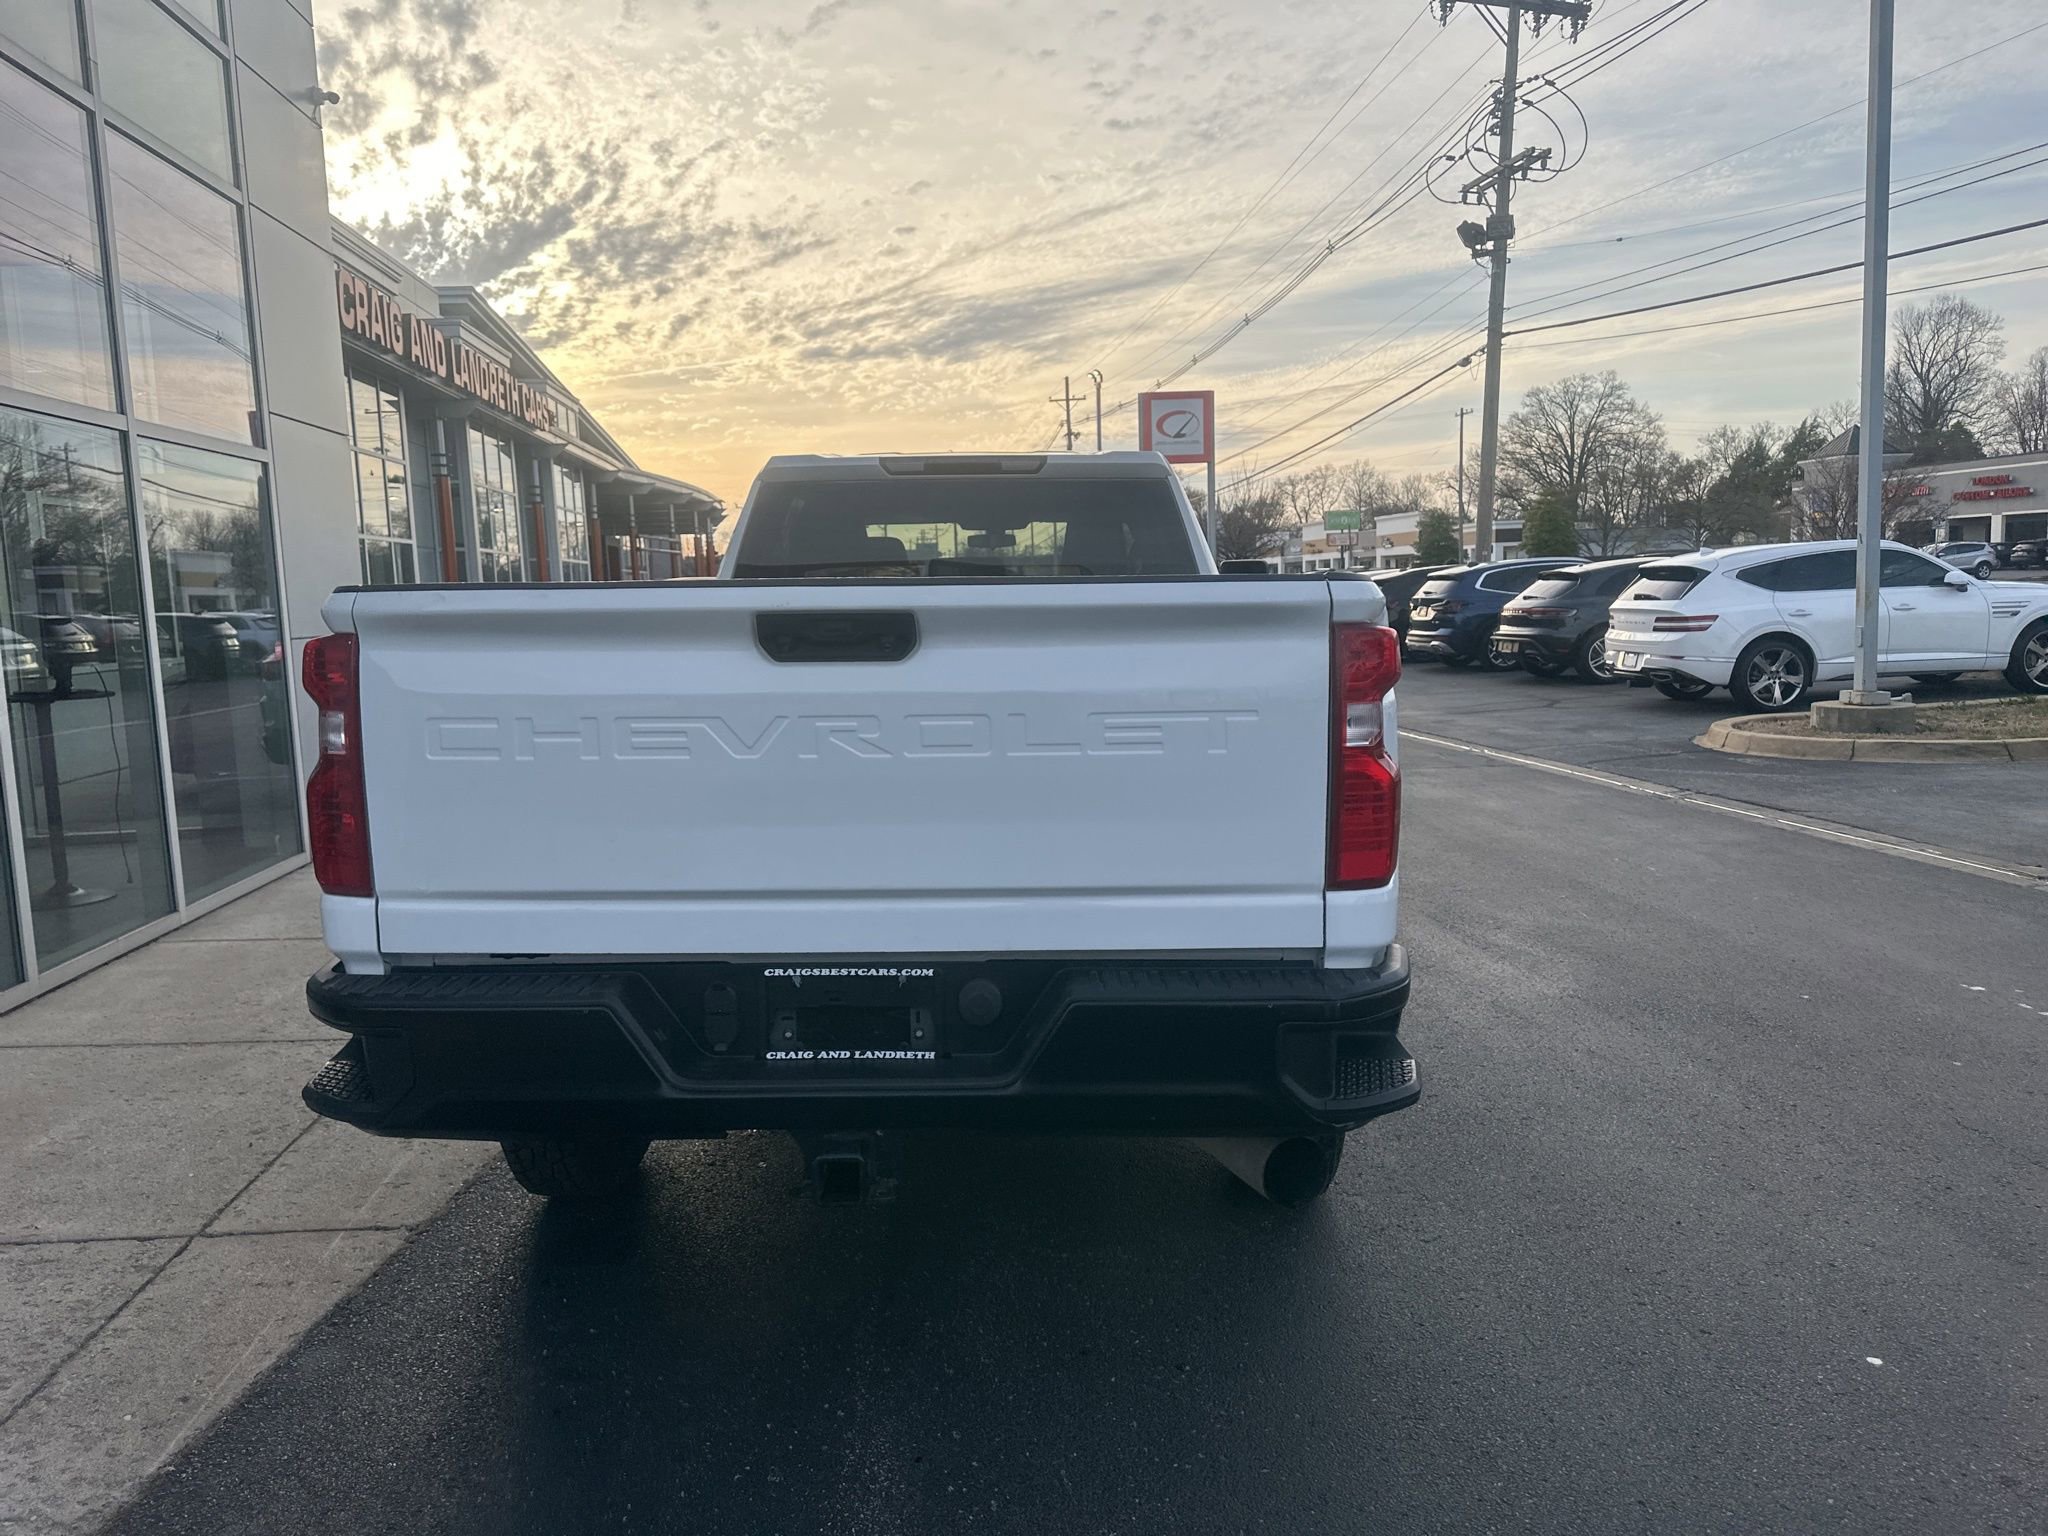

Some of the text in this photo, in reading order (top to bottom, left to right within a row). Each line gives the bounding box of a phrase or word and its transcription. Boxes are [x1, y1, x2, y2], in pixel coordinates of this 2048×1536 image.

[336, 268, 551, 432] CRAIG AND LANDRETH CARS
[424, 710, 1259, 760] CHEVROLET
[764, 968, 935, 977] CRAIGSBESTCARS.COM
[765, 1050, 936, 1060] CRAIG AND LANDRETH
